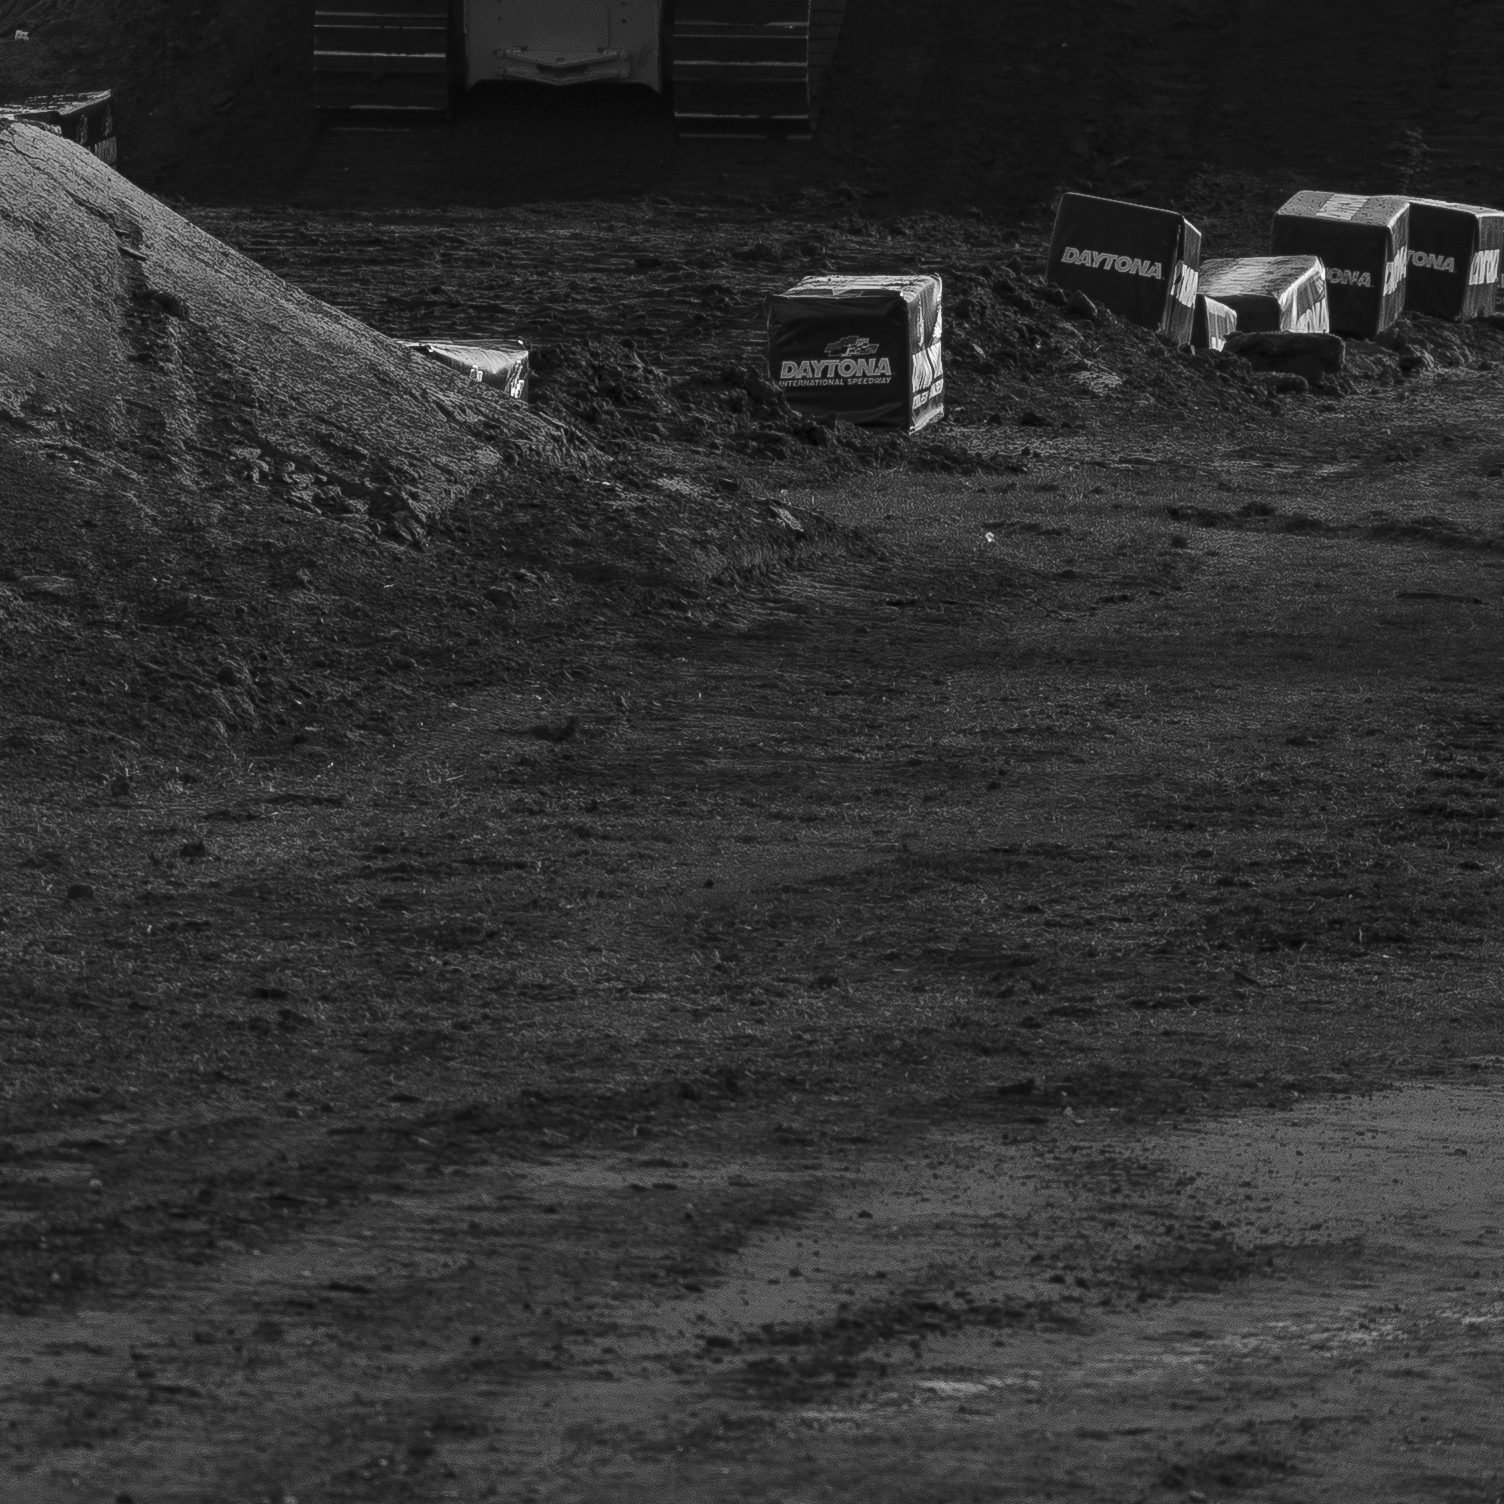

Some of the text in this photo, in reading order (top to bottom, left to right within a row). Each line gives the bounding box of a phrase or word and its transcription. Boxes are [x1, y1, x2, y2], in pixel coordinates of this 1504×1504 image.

[1060, 246, 1165, 281] DAYTONA
[780, 357, 892, 379] DAYTONA
[779, 376, 892, 387] INTERNATIONAL SPEEDWAY
